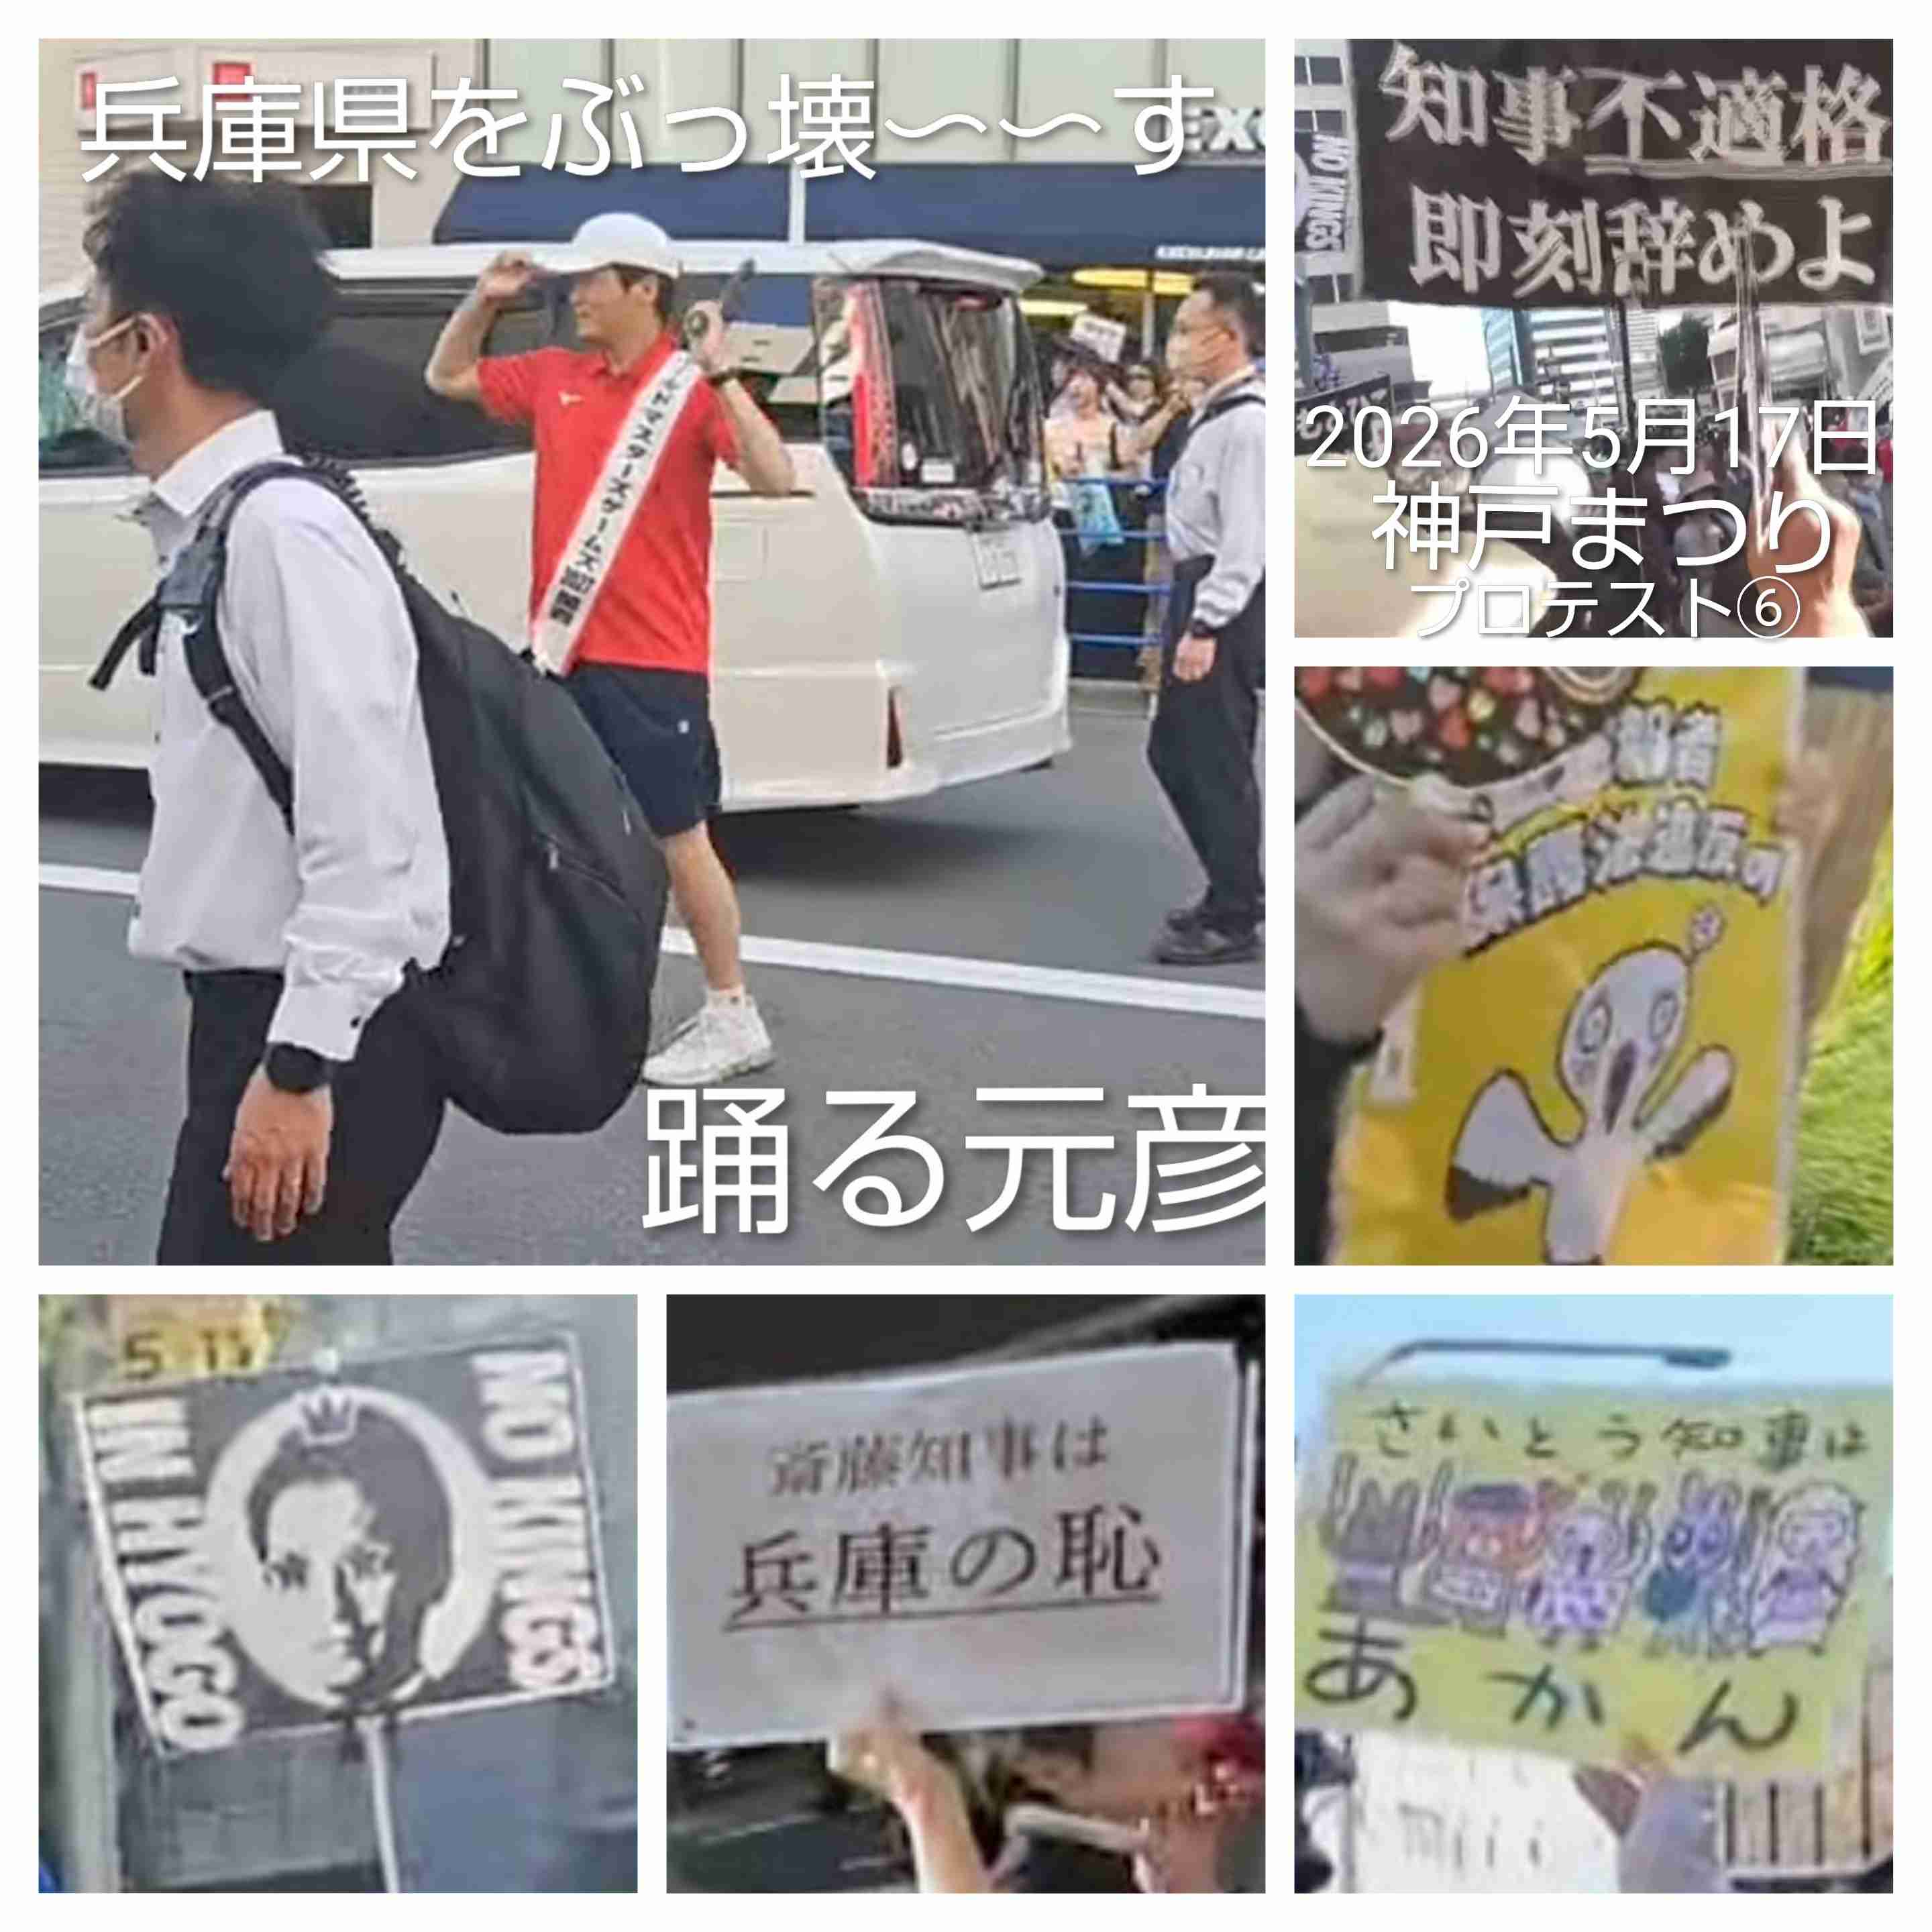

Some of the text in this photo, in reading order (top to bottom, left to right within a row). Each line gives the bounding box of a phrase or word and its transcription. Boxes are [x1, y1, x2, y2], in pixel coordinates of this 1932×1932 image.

[1379, 39, 1890, 166] 知事不適格
[1408, 182, 1876, 298] 即刻辞めよ
[1366, 1399, 1869, 1472] さいとう知事は
[83, 1397, 244, 1752] IN HYOGO
[471, 1348, 602, 1690] NO KINGS
[723, 1503, 1163, 1620] 兵庫の恥
[1302, 1615, 1799, 1754] あかん
